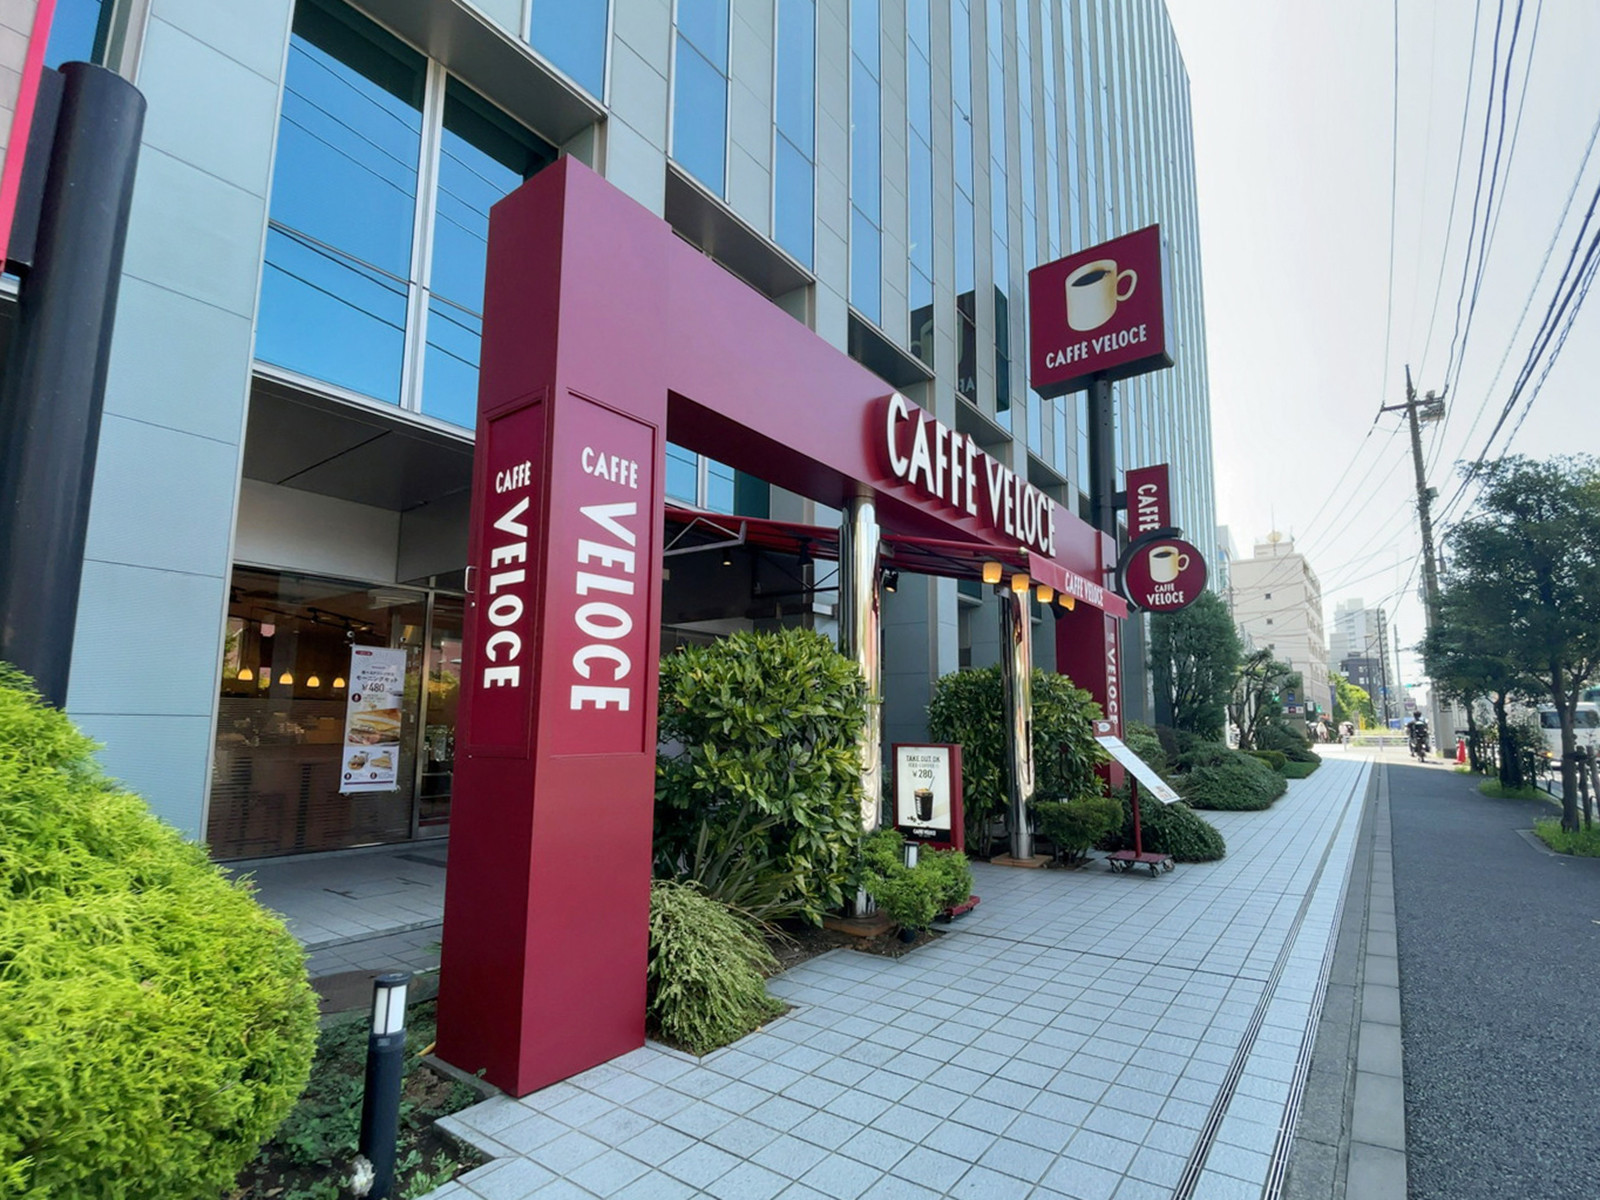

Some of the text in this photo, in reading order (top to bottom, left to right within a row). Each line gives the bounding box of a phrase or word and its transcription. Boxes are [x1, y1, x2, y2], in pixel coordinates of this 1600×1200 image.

[1092, 324, 1147, 355] VELOCE
[984, 453, 1056, 558] VELOCE
[483, 496, 530, 689] VELOCE
[570, 502, 637, 711] VELOCE
[1146, 590, 1184, 606] VELOCE
